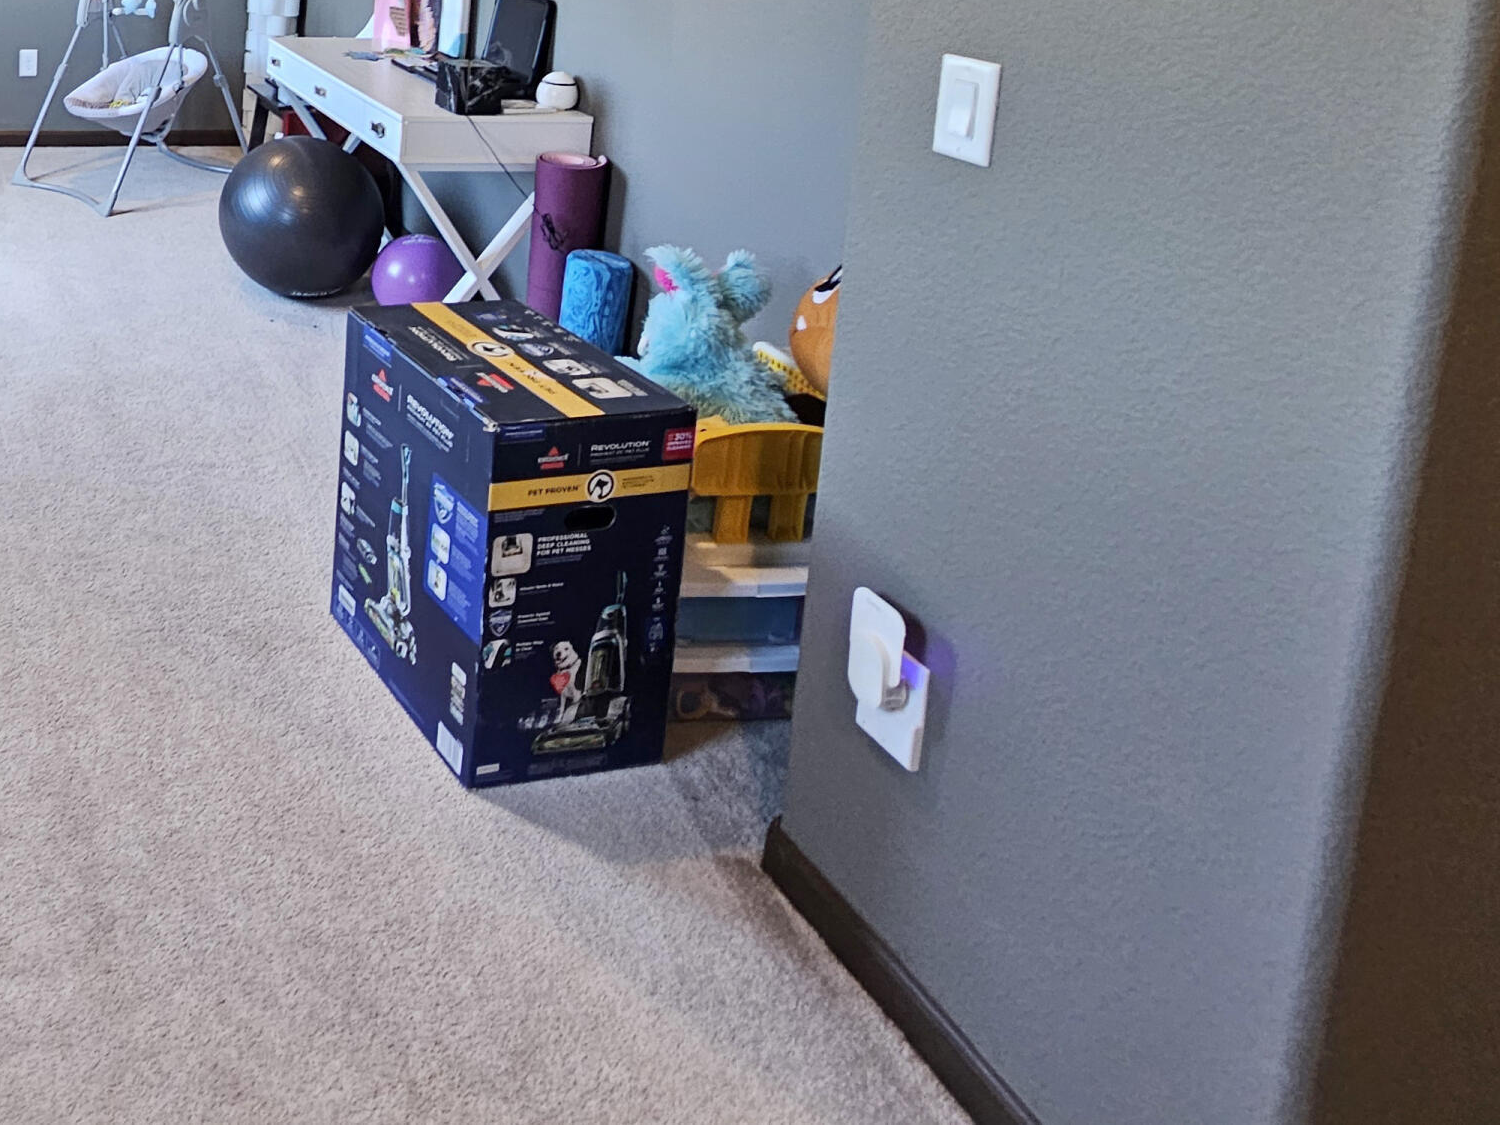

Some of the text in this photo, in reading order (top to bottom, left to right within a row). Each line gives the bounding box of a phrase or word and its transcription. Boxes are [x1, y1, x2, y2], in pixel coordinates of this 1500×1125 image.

[590, 440, 650, 451] REVOLUTION
[528, 485, 579, 496] PET PROVEN
[537, 532, 589, 542] PROFESSIONAL
[556, 539, 590, 548] CLEANING
[536, 548, 550, 557] FOR
[551, 546, 565, 554] PET
